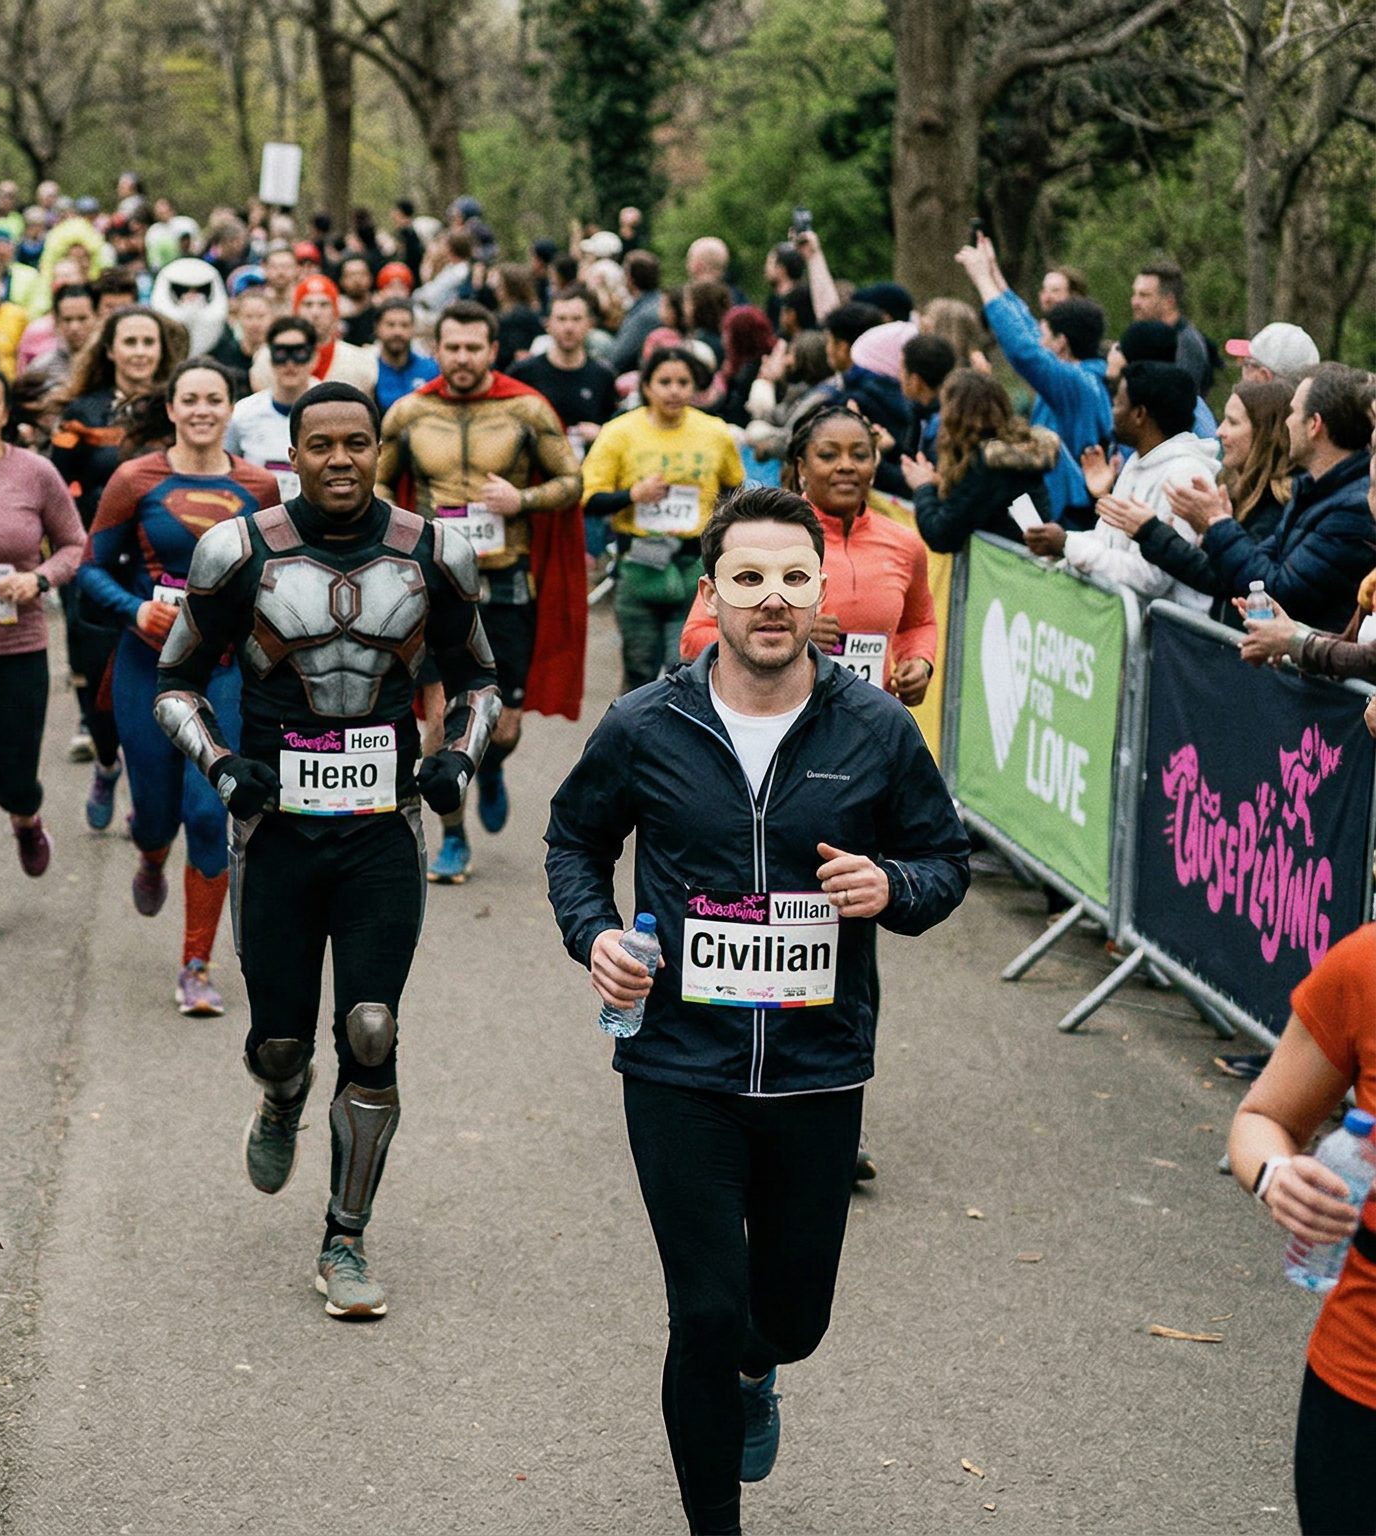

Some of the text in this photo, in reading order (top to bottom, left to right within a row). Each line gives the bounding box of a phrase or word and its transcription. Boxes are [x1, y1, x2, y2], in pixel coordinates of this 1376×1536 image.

[850, 639, 883, 653] Hero
[1034, 620, 1096, 700] GAMES
[1030, 678, 1054, 721] FOR
[351, 732, 390, 749] Hero
[1026, 718, 1090, 827] LOVE
[690, 931, 831, 973] Civilian
